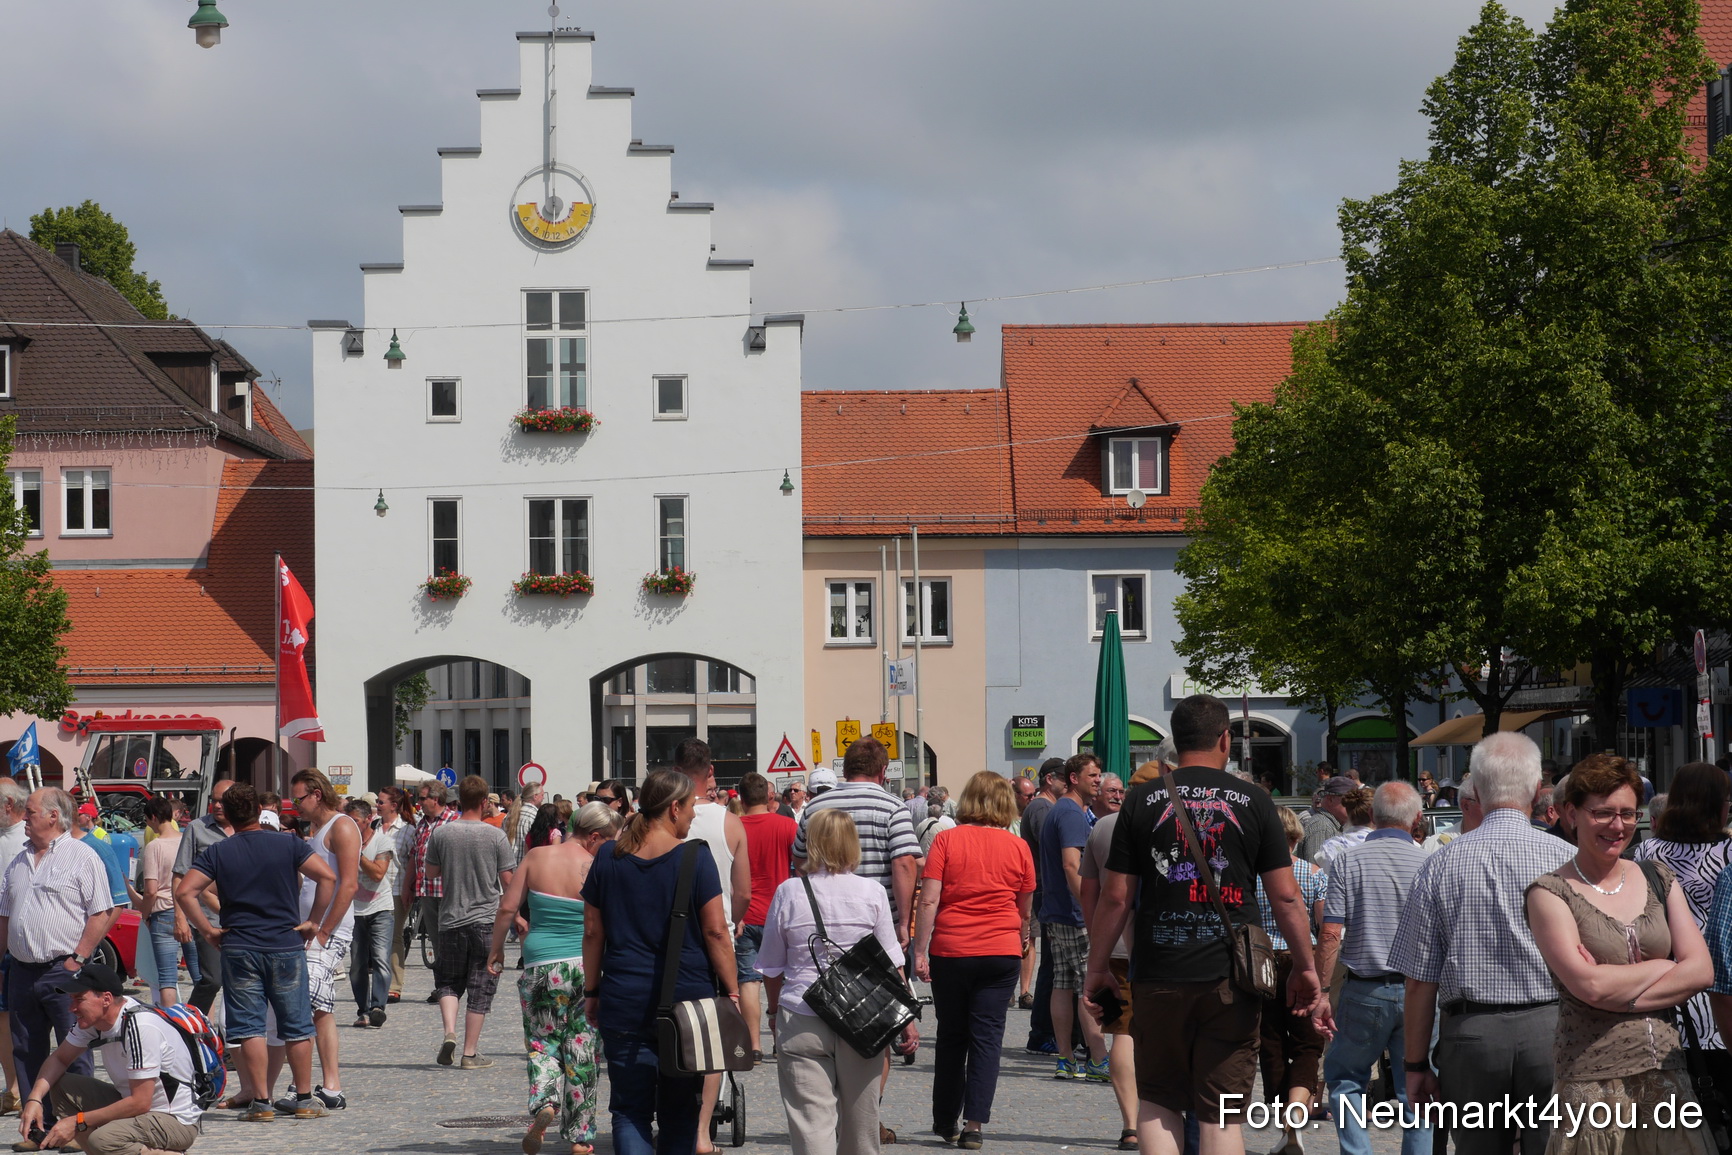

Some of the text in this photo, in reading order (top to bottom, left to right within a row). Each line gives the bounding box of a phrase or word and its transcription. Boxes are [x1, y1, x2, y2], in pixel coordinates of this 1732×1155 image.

[541, 230, 550, 239] 10
[552, 232, 561, 240] 12
[566, 227, 575, 236] 14
[580, 209, 589, 217] 16
[1013, 730, 1043, 738] FRISEUR
[1223, 789, 1251, 808] TOUR
